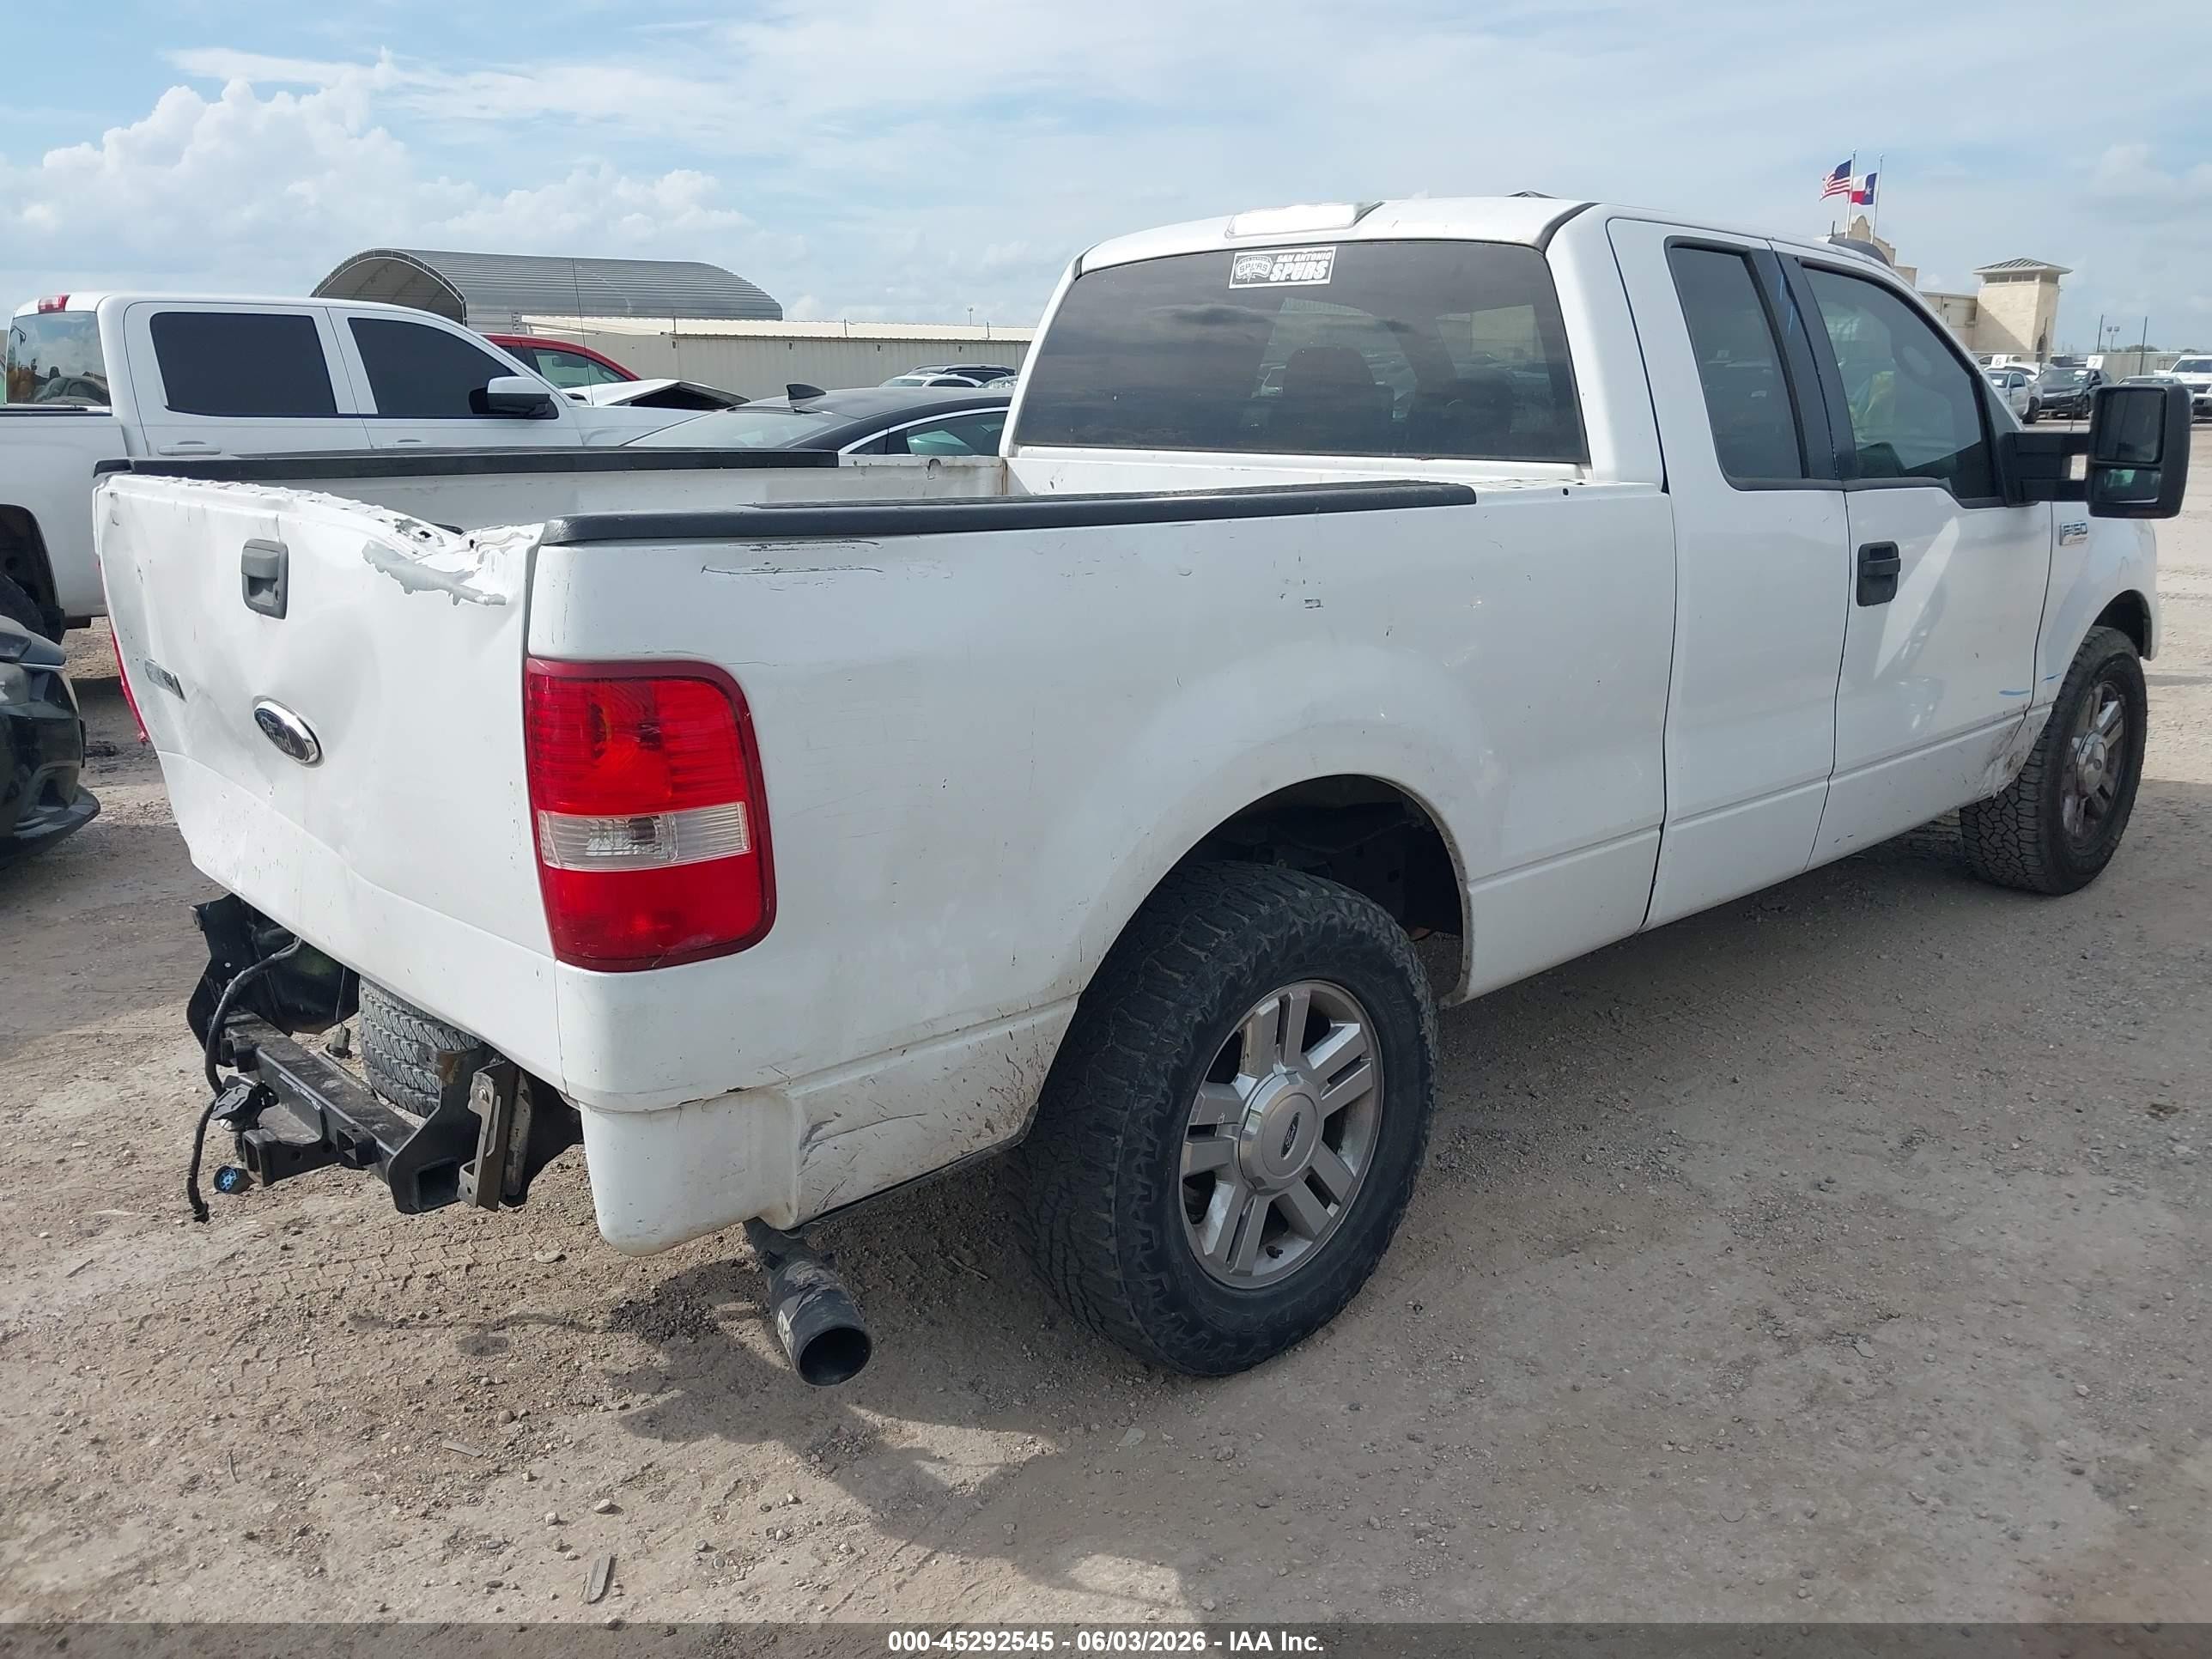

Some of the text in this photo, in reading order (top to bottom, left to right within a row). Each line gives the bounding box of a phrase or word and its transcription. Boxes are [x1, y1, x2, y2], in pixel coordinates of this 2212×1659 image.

[1276, 253, 1294, 263] SAN
[1293, 252, 1332, 262] ANTONIO
[1269, 260, 1329, 282] SPURS
[1995, 356, 2002, 365] 6
[2091, 357, 2100, 367] 7
[260, 715, 297, 755] Ford
